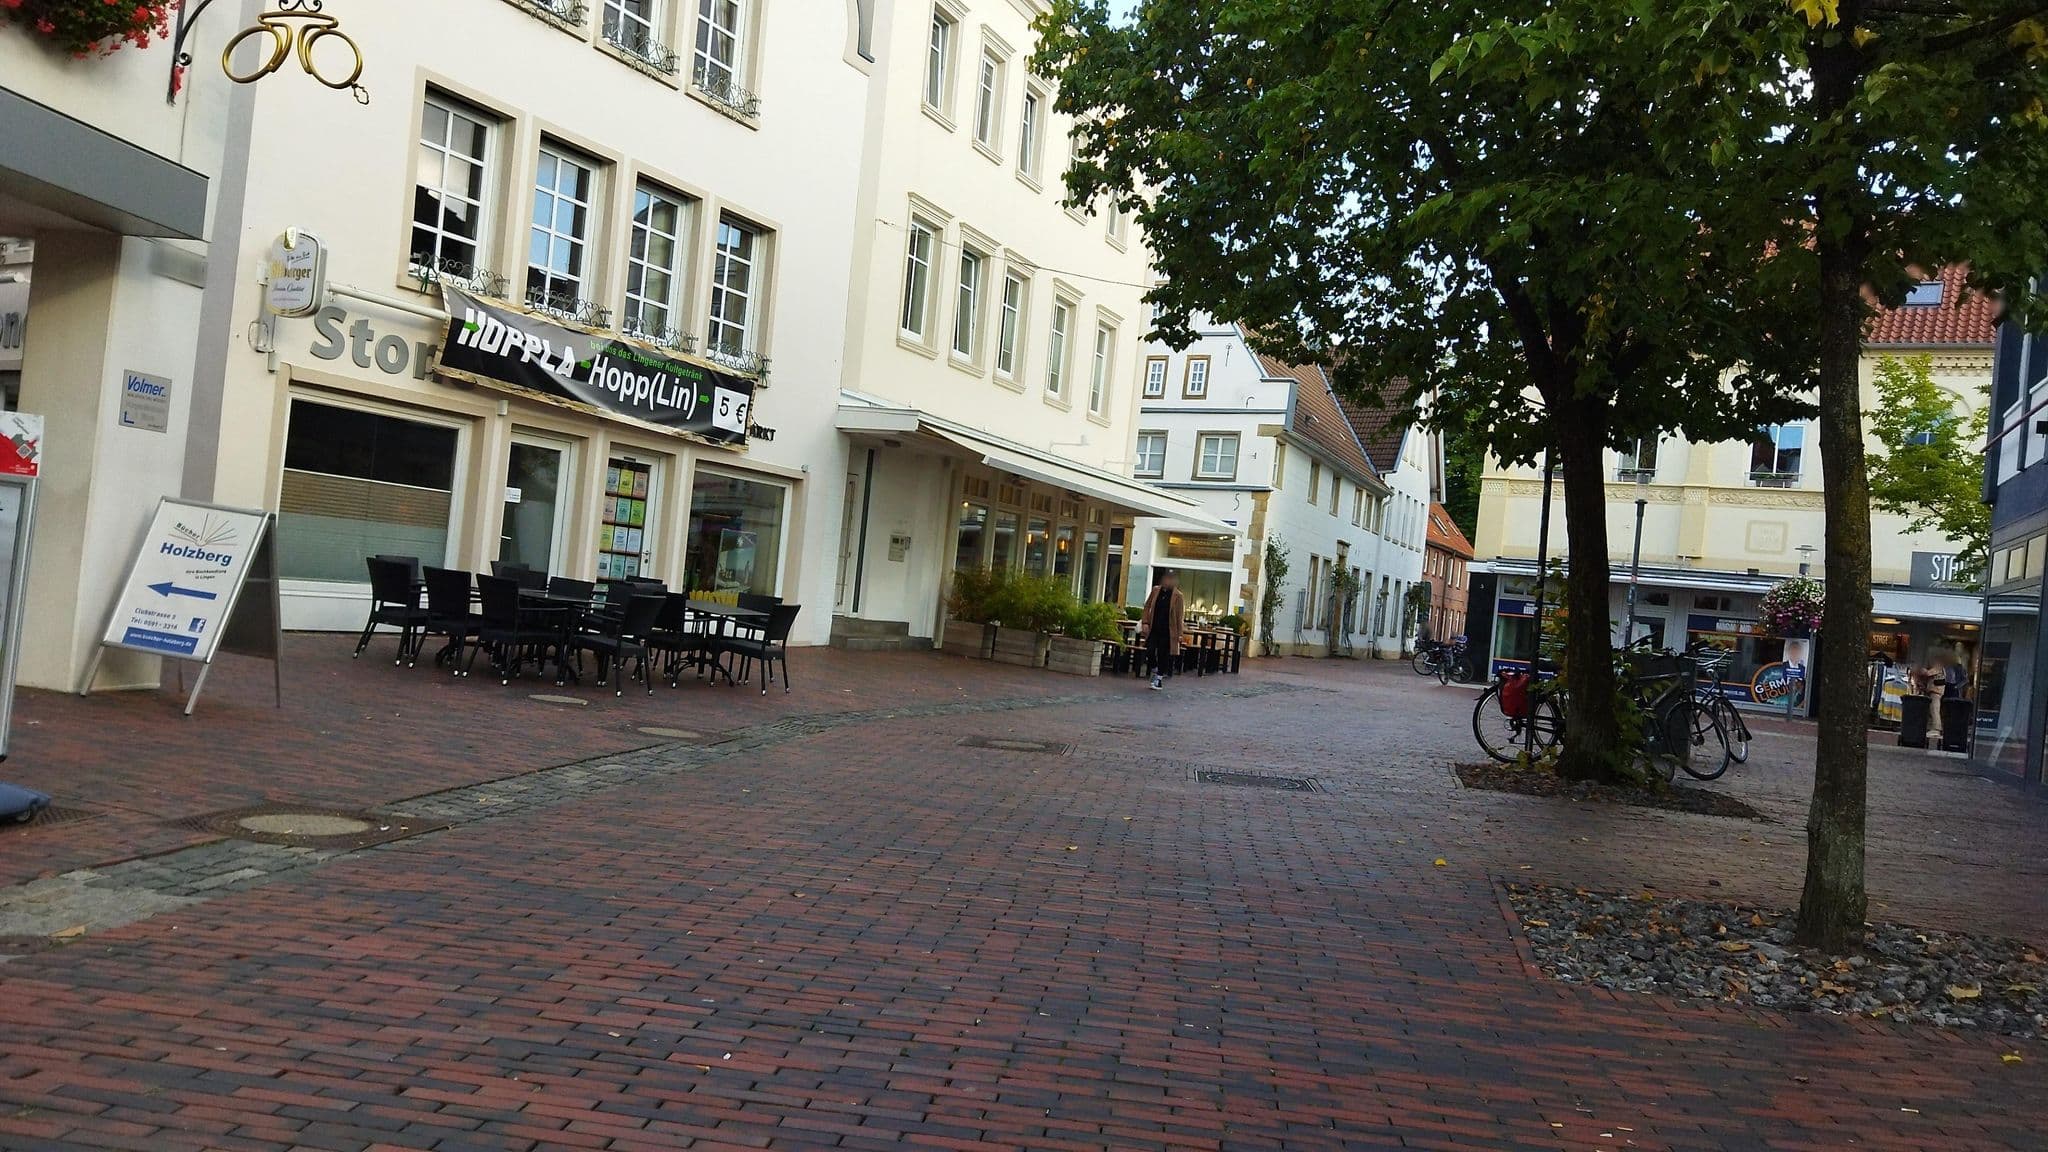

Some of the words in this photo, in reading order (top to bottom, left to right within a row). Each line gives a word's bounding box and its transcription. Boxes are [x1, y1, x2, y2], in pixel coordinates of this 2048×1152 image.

[457, 307, 576, 379] HOPPLA
[618, 348, 632, 360] das
[632, 351, 665, 369] Lingener
[665, 362, 704, 381] Kultgetränk
[127, 375, 165, 396] Volmer
[588, 353, 698, 421] Hopp(Lin)
[719, 396, 729, 417] 5
[735, 403, 747, 425] €
[176, 522, 201, 539] Bücher
[160, 542, 233, 566] Holzberg
[1754, 677, 1802, 694] GERMA
[1760, 685, 1792, 701] LIQUI
